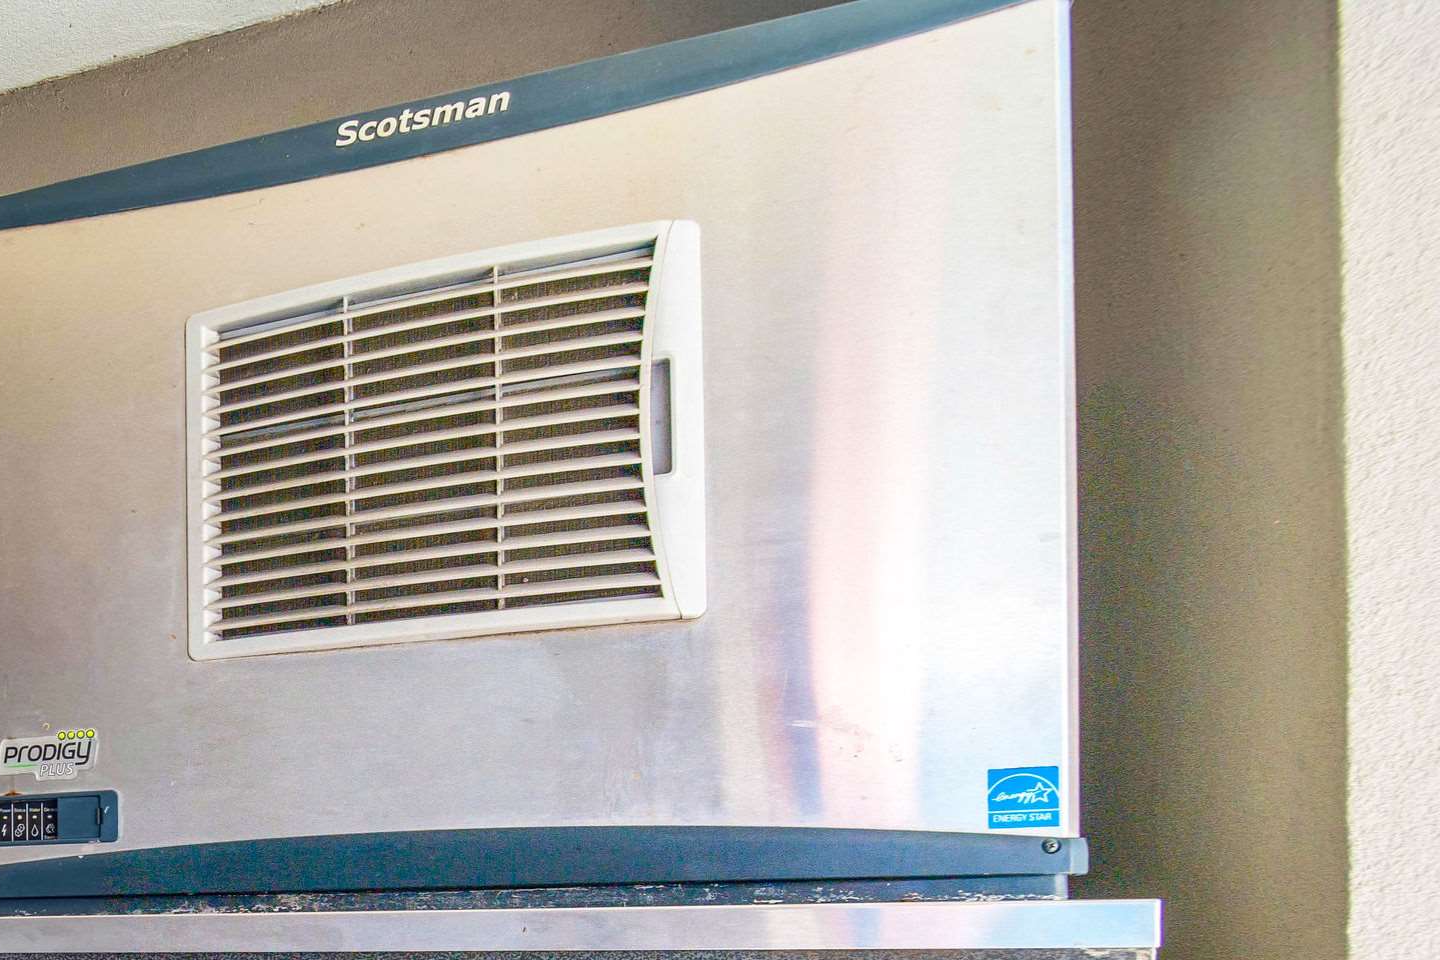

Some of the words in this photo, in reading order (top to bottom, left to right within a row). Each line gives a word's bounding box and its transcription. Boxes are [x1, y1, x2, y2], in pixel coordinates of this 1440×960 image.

[335, 91, 511, 147] Scotsman
[40, 762, 74, 777] PLUS
[992, 814, 1027, 823] ENERGY
[1029, 812, 1052, 822] STAR
